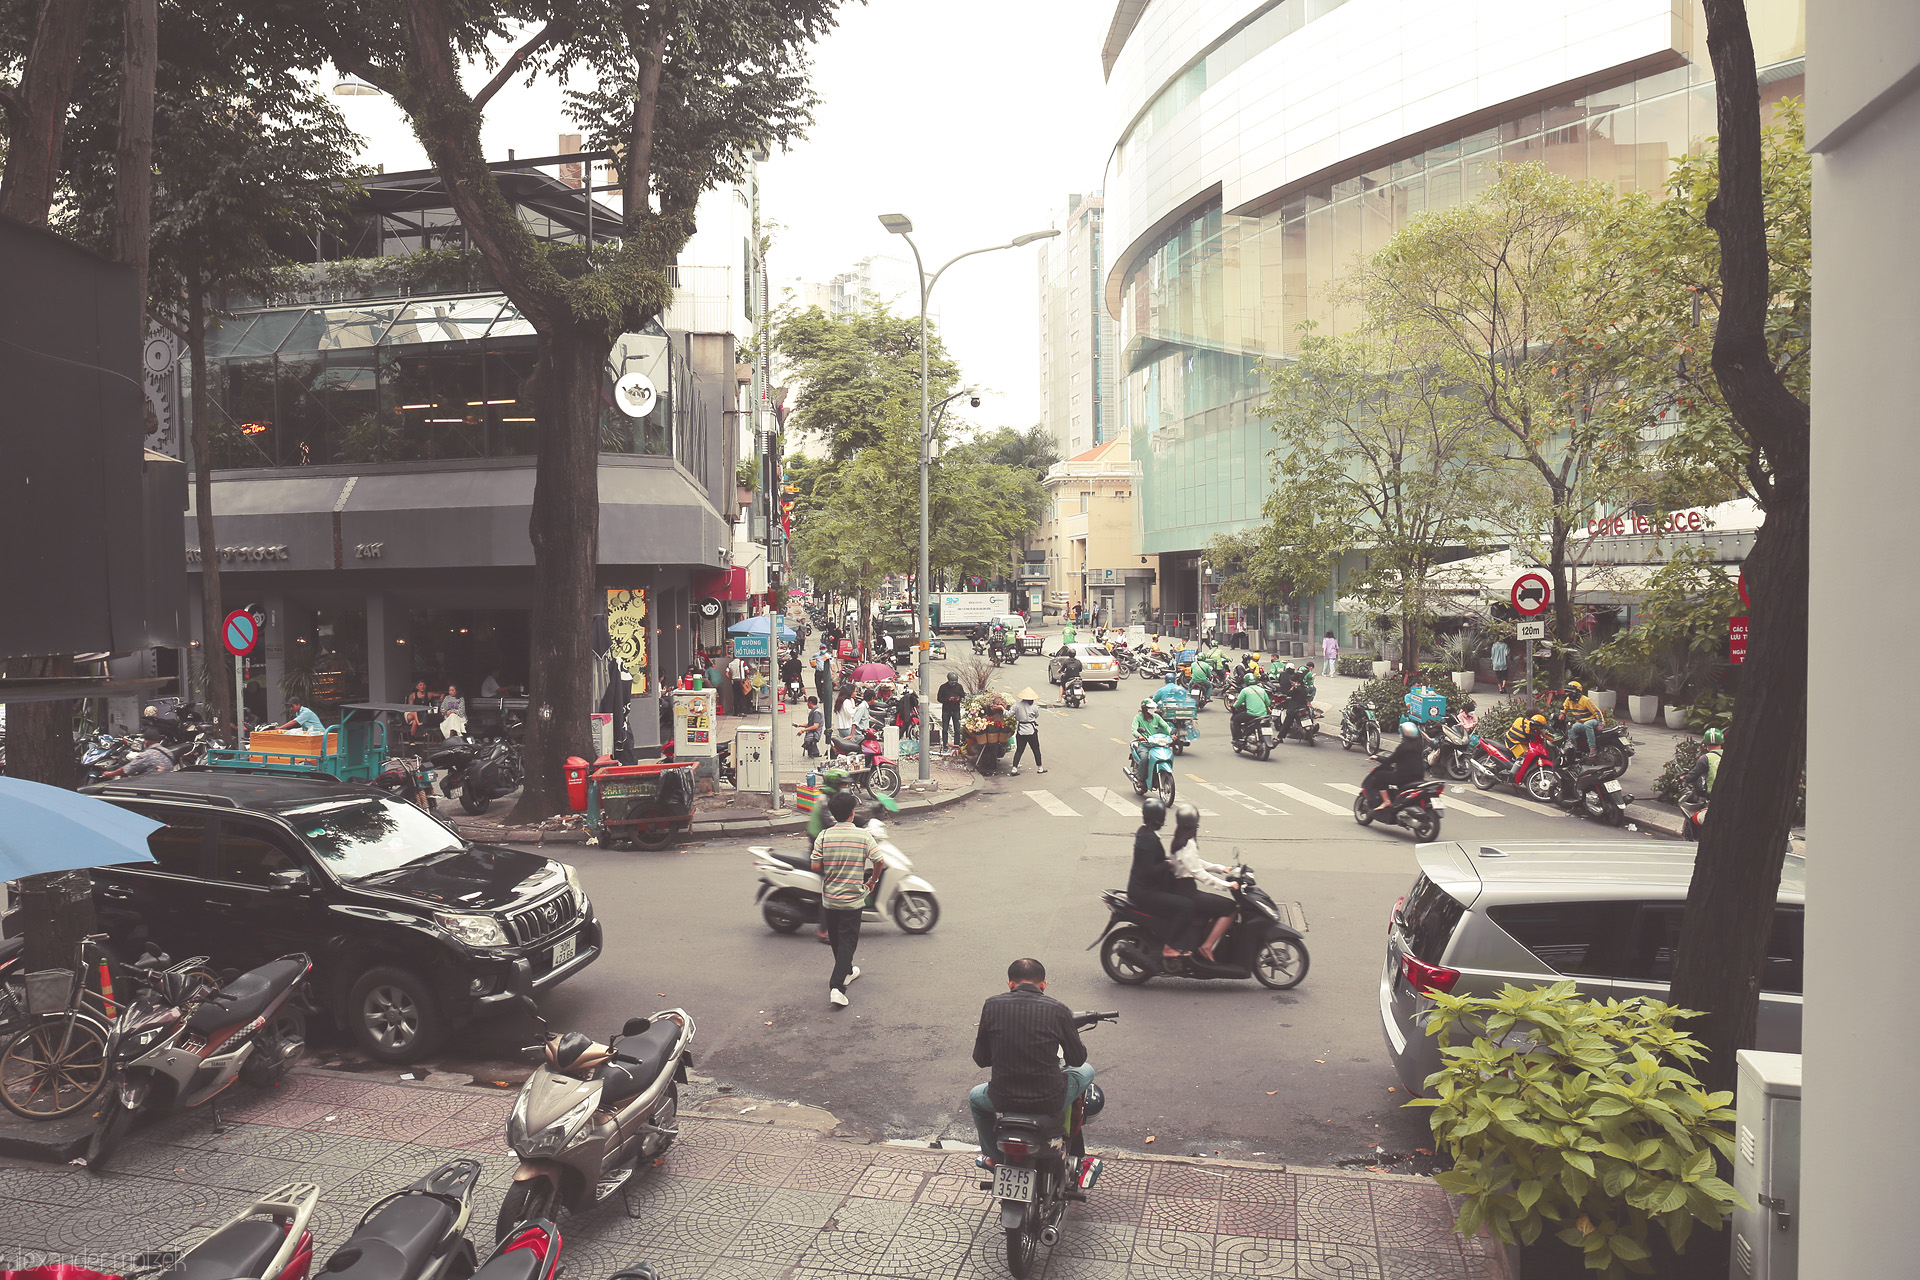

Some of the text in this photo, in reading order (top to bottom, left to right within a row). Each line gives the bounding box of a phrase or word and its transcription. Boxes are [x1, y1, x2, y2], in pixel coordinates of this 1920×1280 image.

[1587, 514, 1625, 536] cafe
[1105, 569, 1113, 579] P
[1522, 626, 1540, 636] 120m
[998, 1183, 1028, 1199] 3579
